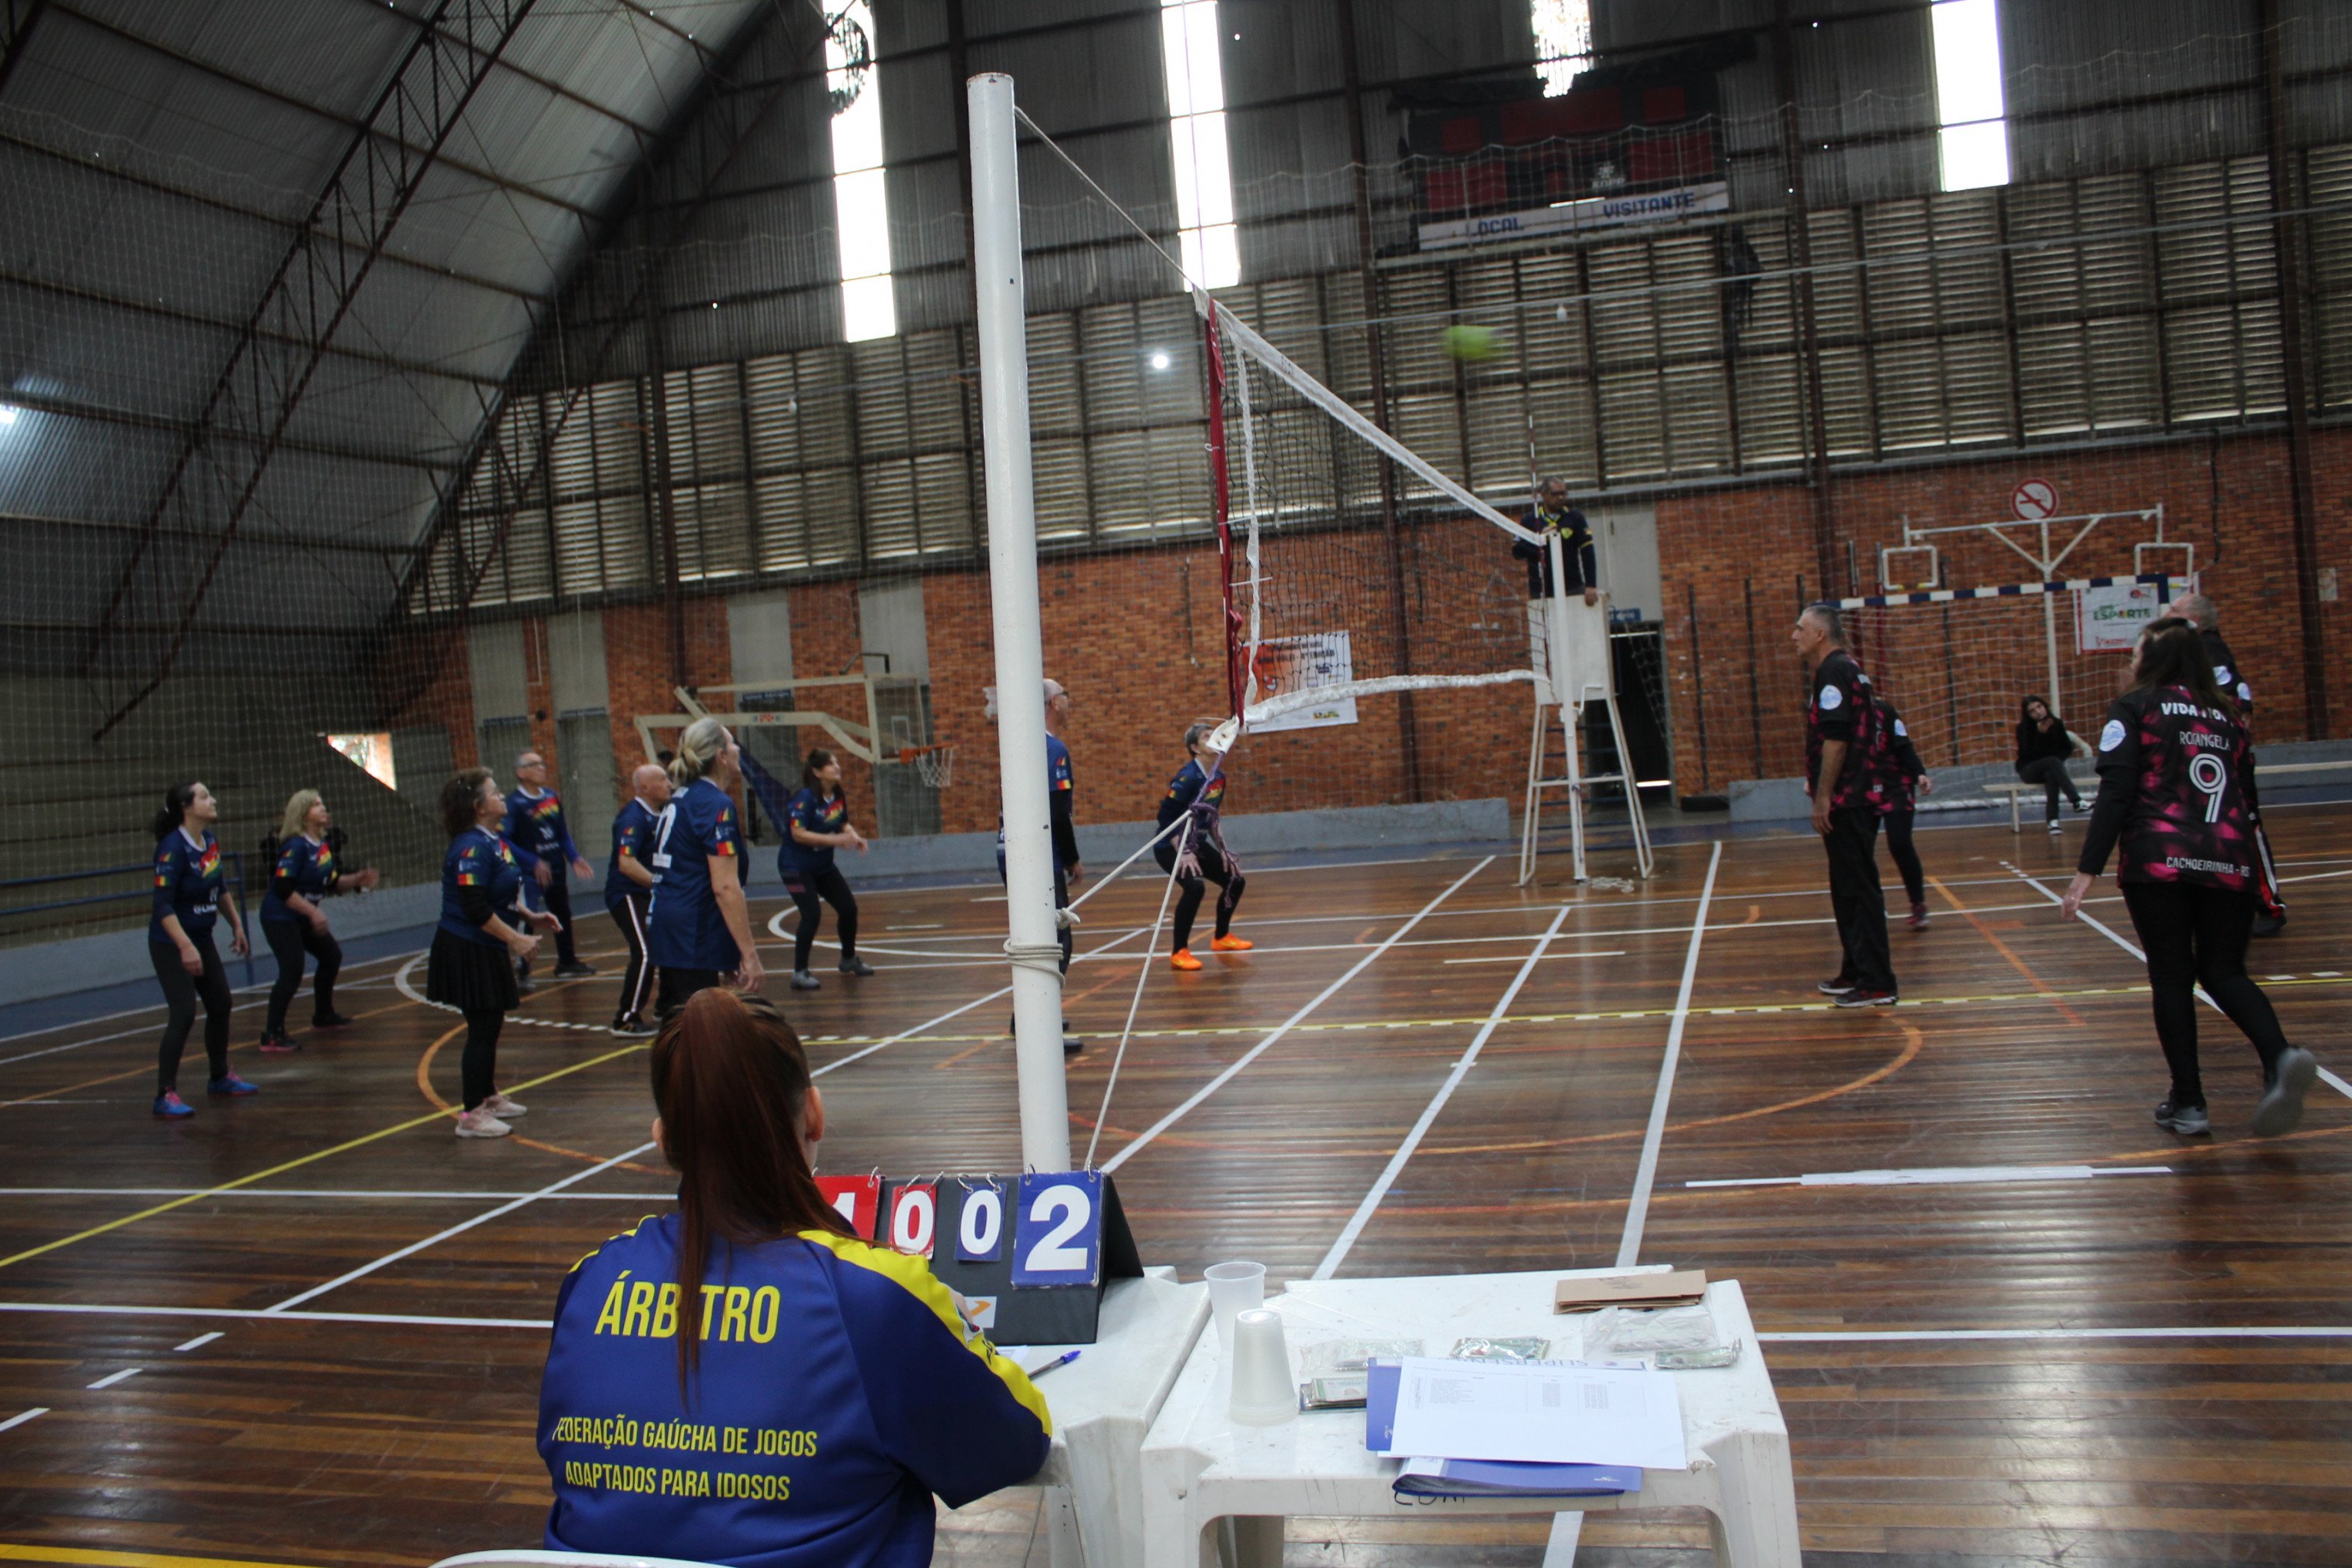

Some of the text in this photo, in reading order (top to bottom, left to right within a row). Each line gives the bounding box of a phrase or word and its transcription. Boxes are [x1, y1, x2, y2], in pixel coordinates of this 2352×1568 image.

[1603, 193, 1696, 218] VISITANTE
[1465, 217, 1525, 237] LOCAL
[2161, 702, 2198, 717] VIDA
[2189, 753, 2227, 823] 9
[2166, 856, 2234, 875] CACHOEIRINHA
[894, 1190, 934, 1255] 0
[961, 1189, 1002, 1255] 0
[1025, 1184, 1091, 1271] 2
[594, 1270, 780, 1344] ÁRBTRO
[552, 1414, 818, 1457] FEDERAÇÃO GAÚCHA DE JOGOS
[566, 1460, 791, 1501] ADAPTADOS PARA IDOSOS
